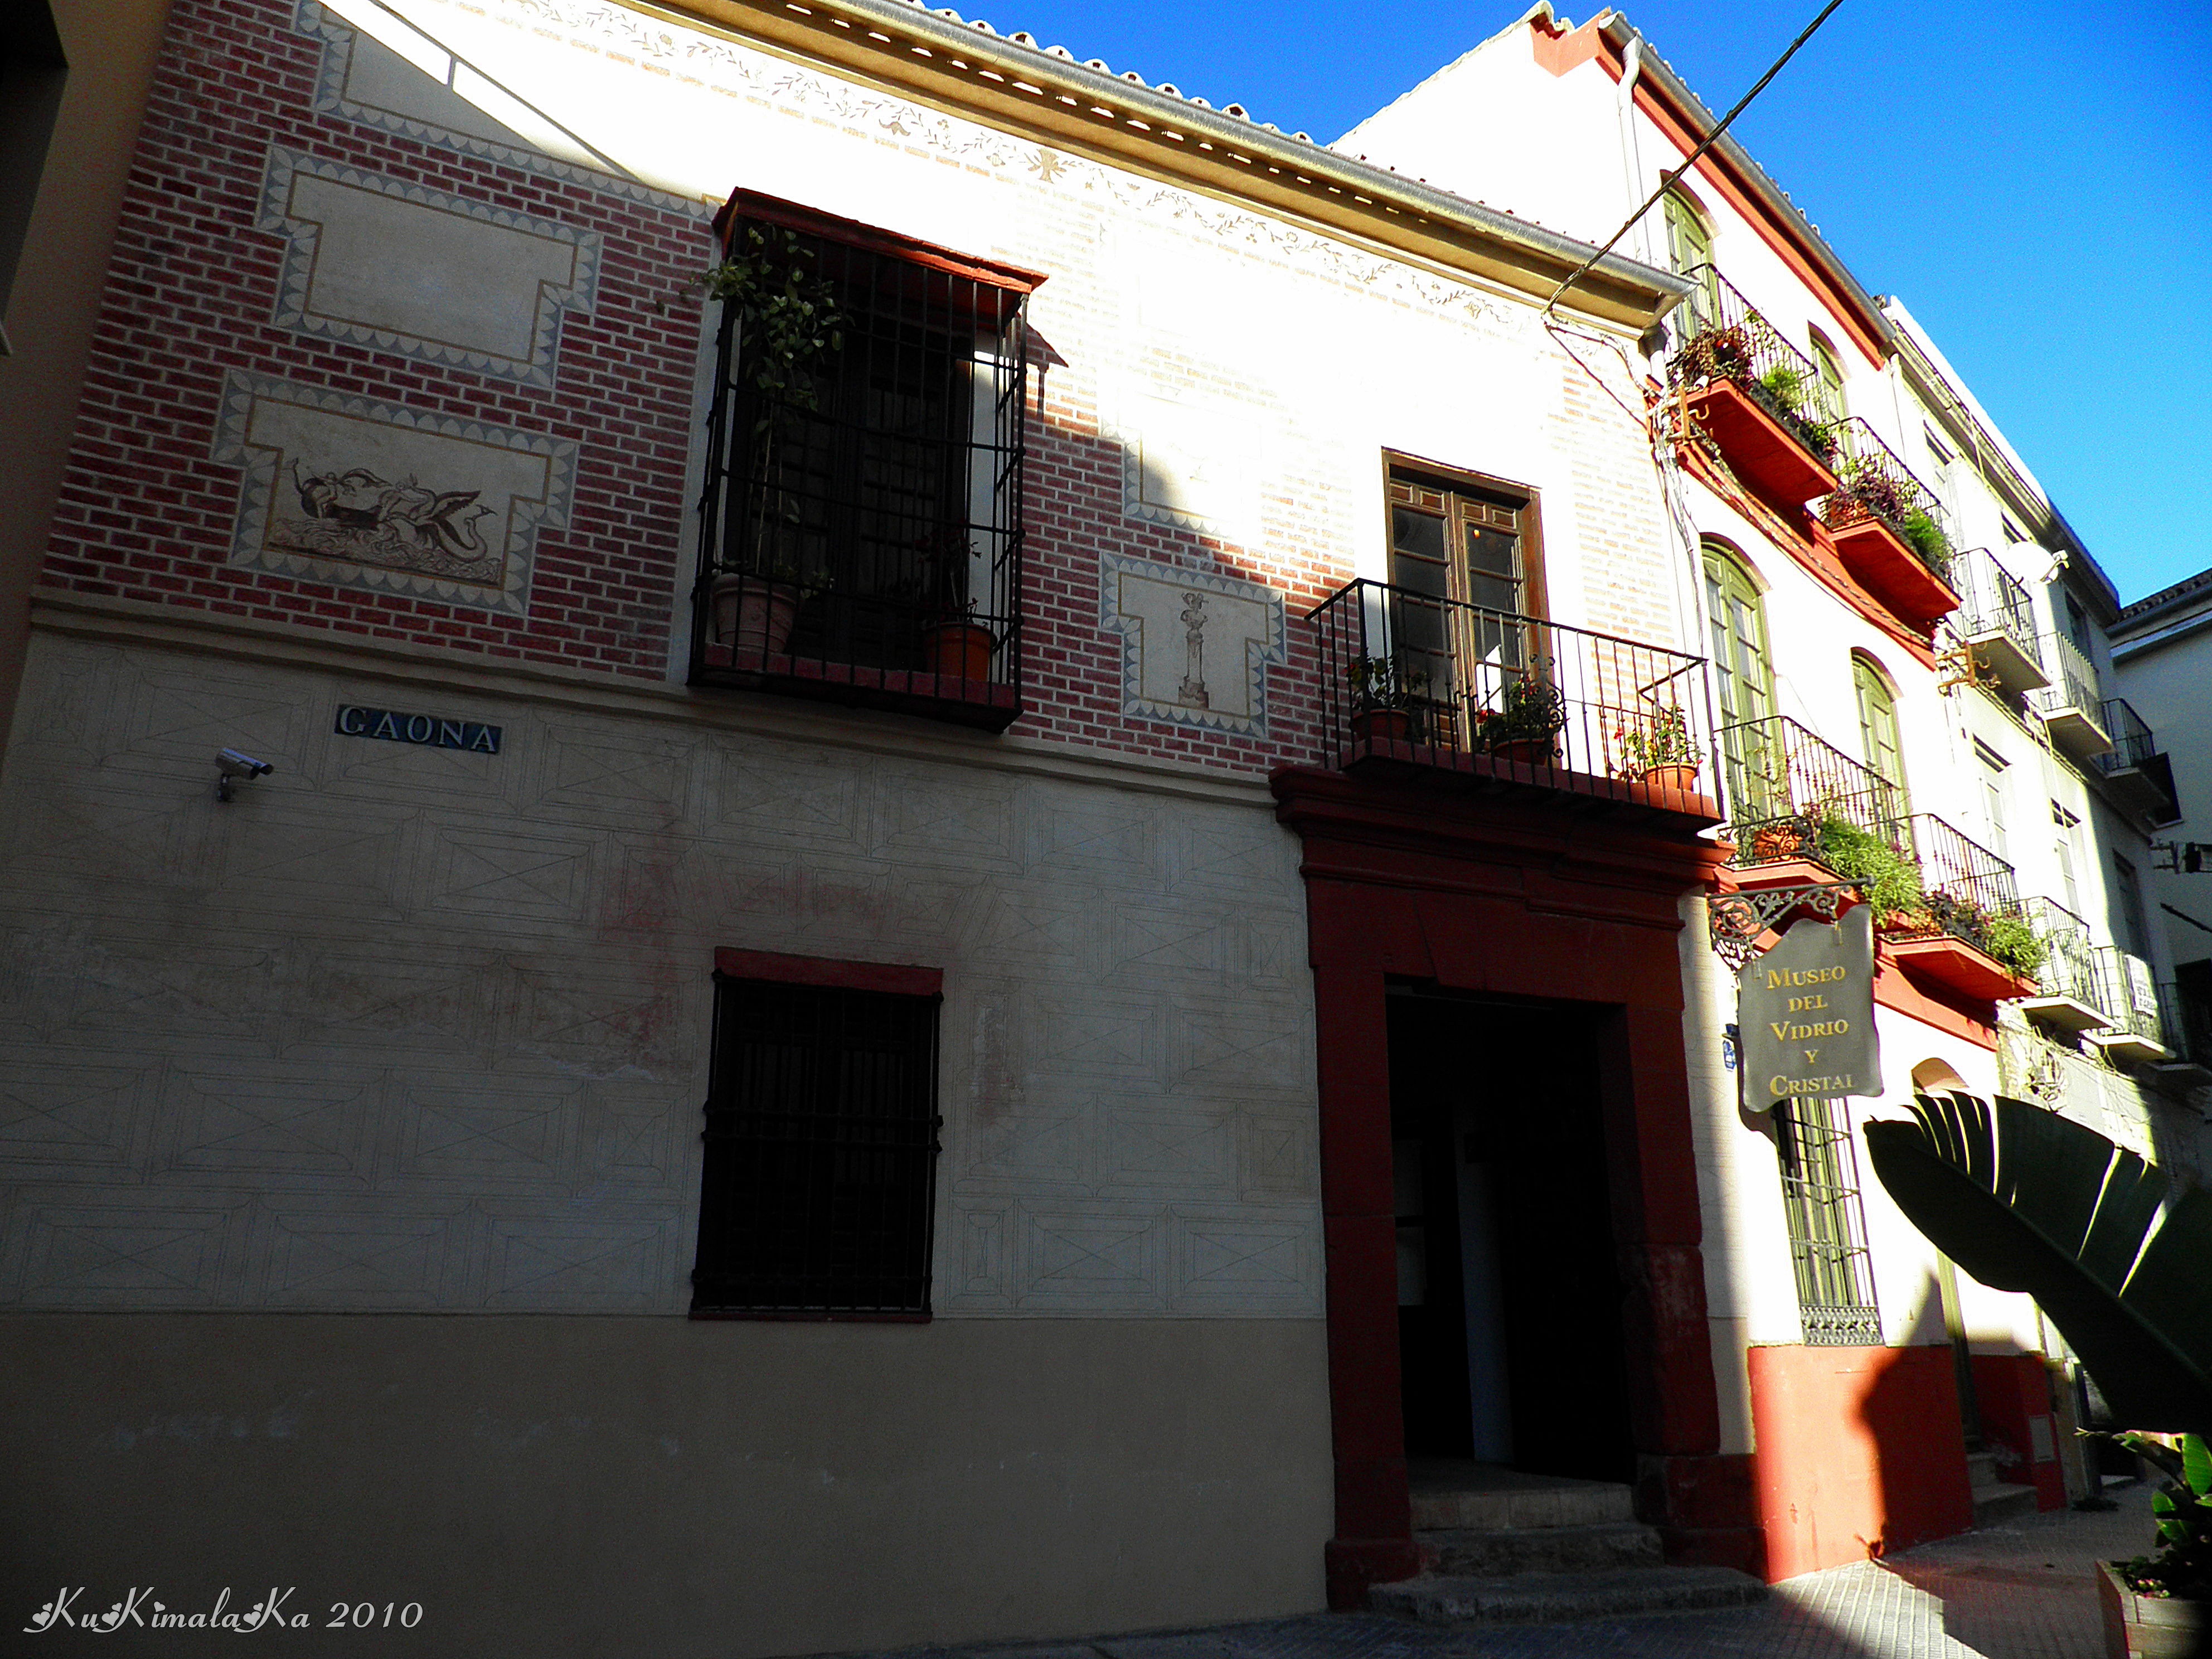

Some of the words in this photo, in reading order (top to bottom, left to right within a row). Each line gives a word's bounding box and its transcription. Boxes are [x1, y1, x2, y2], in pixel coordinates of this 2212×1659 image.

[340, 706, 496, 752] GAONA
[1767, 966, 1846, 989] MUSEO
[1788, 994, 1828, 1013] DEL
[1769, 1019, 1849, 1041] VIDRIO
[1804, 1049, 1819, 1064] Y
[1769, 1074, 1855, 1097] CRISTAL
